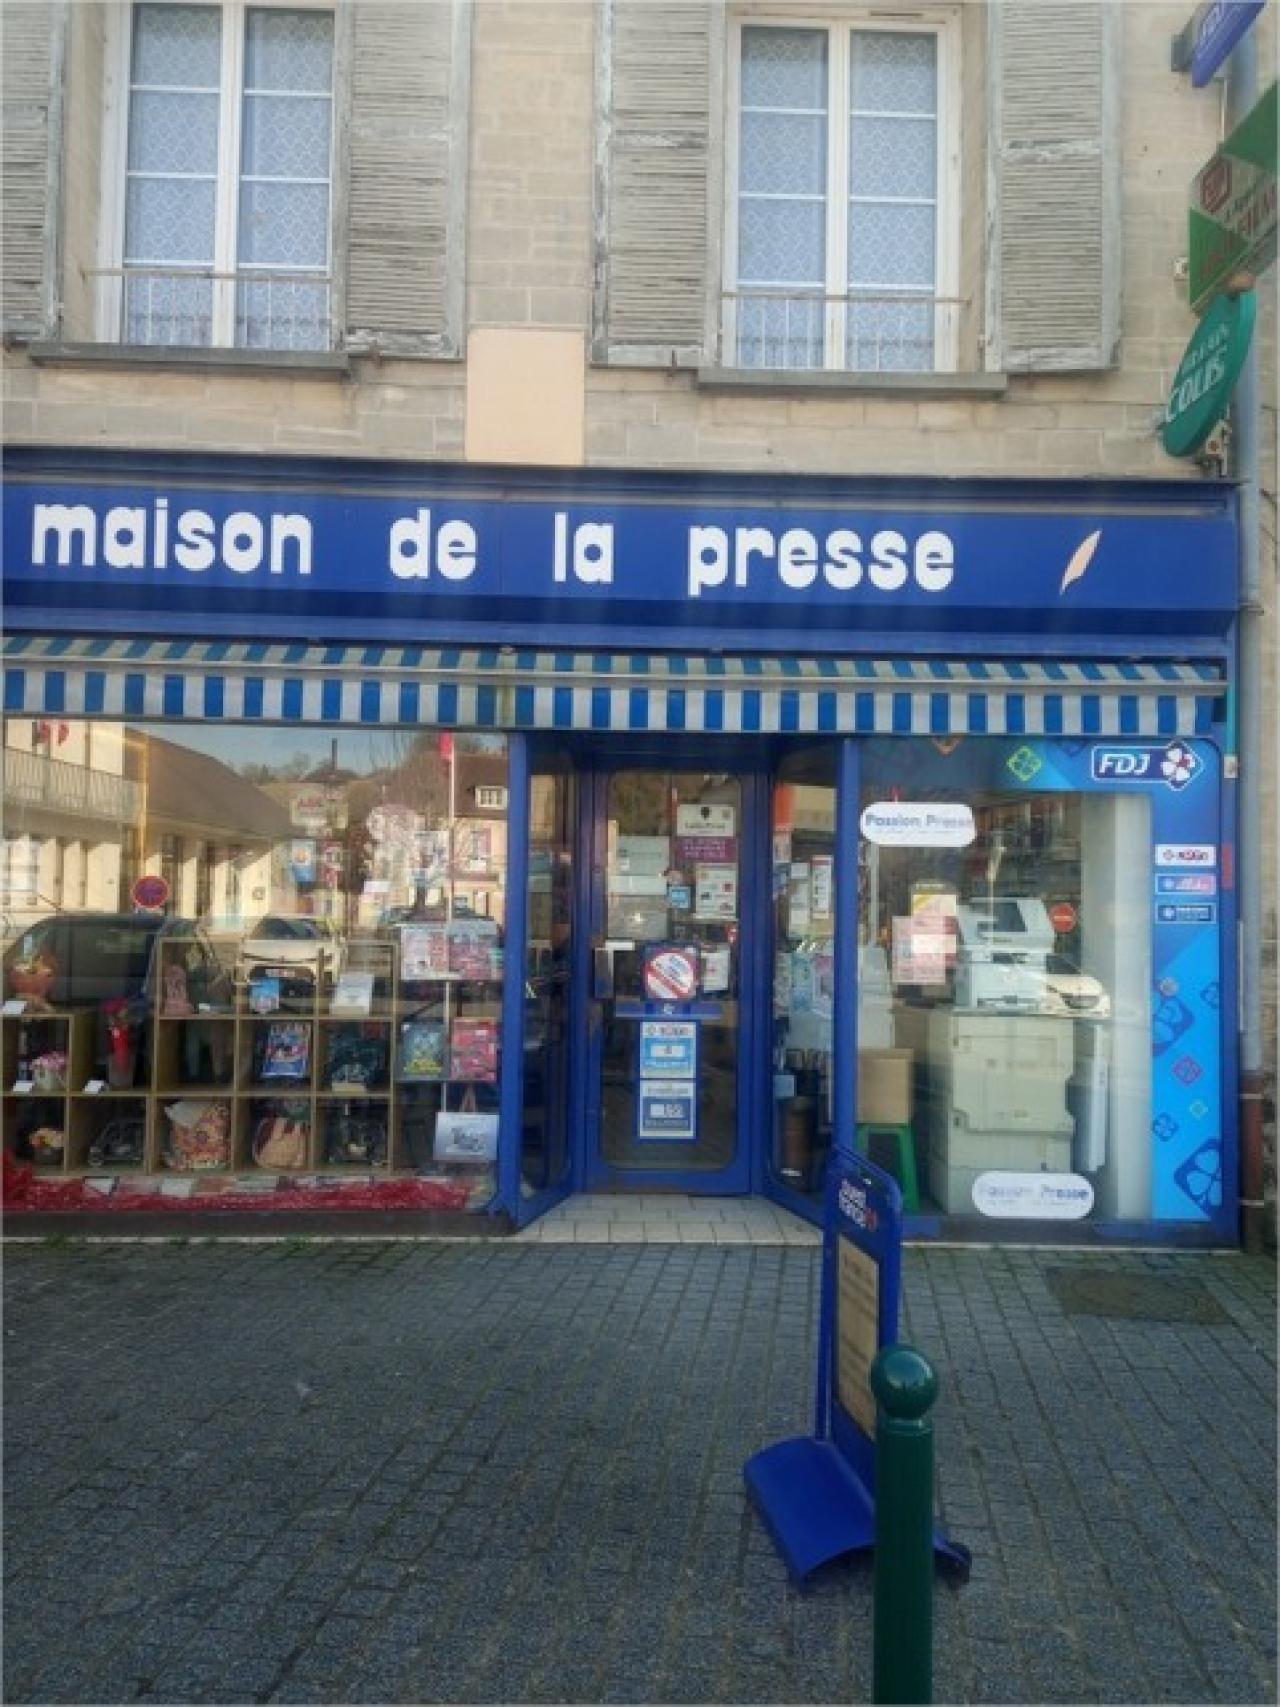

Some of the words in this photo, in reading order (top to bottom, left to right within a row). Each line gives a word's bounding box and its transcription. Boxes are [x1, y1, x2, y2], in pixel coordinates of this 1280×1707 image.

[31, 498, 312, 574] maison
[389, 507, 477, 580] de
[554, 512, 614, 583] la
[689, 526, 954, 596] presse
[1099, 753, 1150, 775] FDJ
